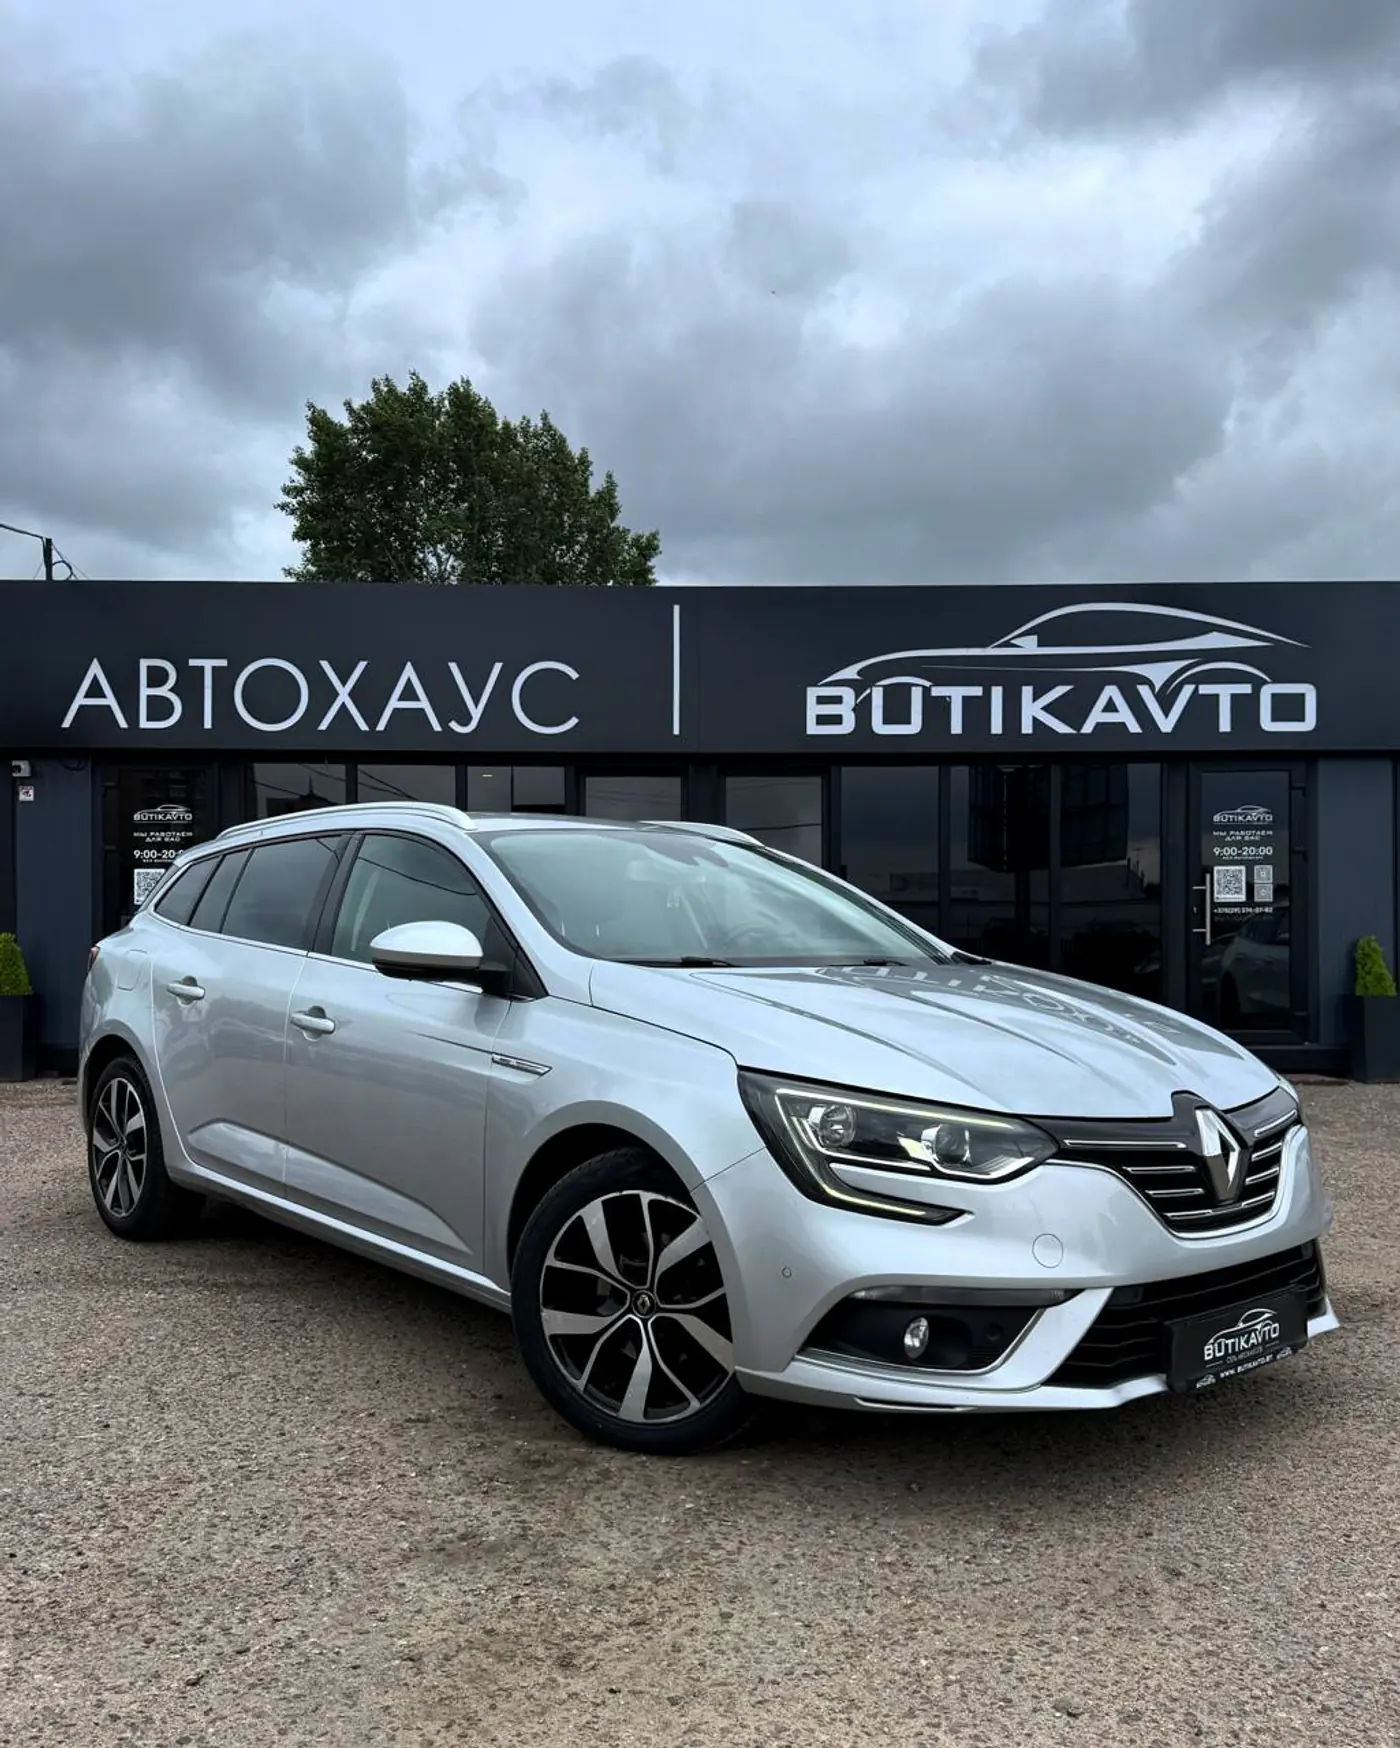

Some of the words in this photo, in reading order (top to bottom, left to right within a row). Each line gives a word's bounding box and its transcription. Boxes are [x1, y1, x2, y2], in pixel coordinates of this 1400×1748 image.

[61, 657, 580, 735] АВТОХАУС
[805, 684, 1318, 736] BUTIKAVTO
[133, 812, 193, 821] BUTIKAVTO
[1213, 813, 1273, 822] BUTIKAVTO
[1213, 846, 1273, 857] 9:00-20:00
[1204, 1322, 1280, 1361] BUTIKAVTO
